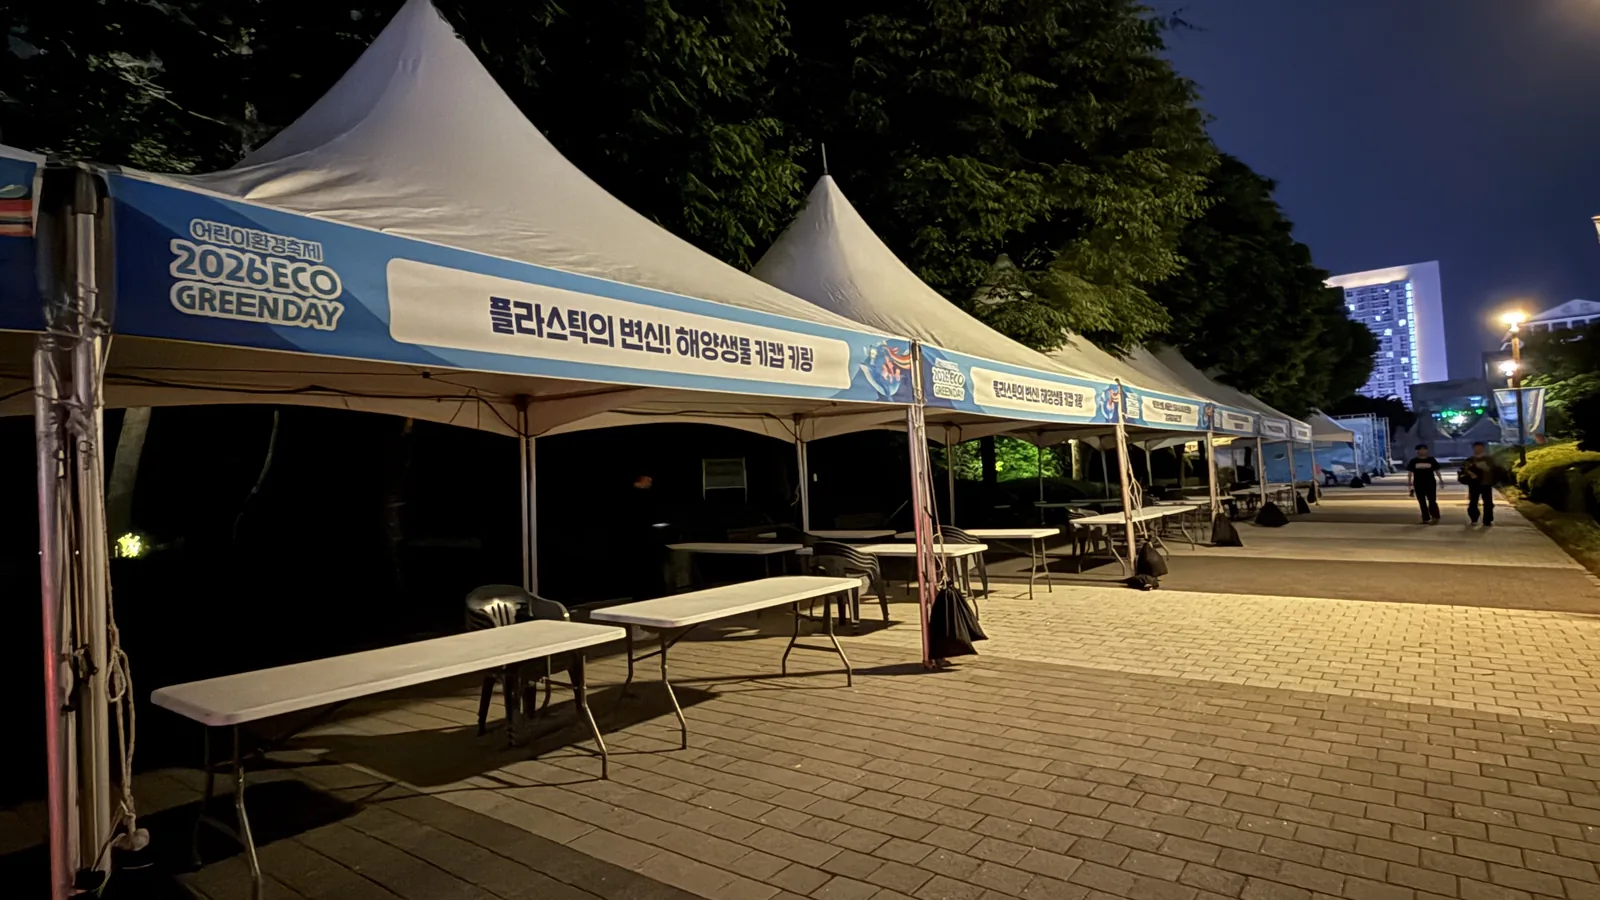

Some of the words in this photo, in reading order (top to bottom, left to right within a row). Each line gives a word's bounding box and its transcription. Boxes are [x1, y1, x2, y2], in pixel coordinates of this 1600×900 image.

[191, 220, 323, 262] 어린이환경축제
[175, 285, 341, 328] GREENDAY
[489, 295, 615, 348] 플라스틱의
[619, 317, 672, 355] 변신!
[675, 326, 752, 366] 해양생물
[754, 339, 785, 370] 키캡
[787, 344, 814, 373] 키링
[993, 380, 1025, 401] 플라스틱의
